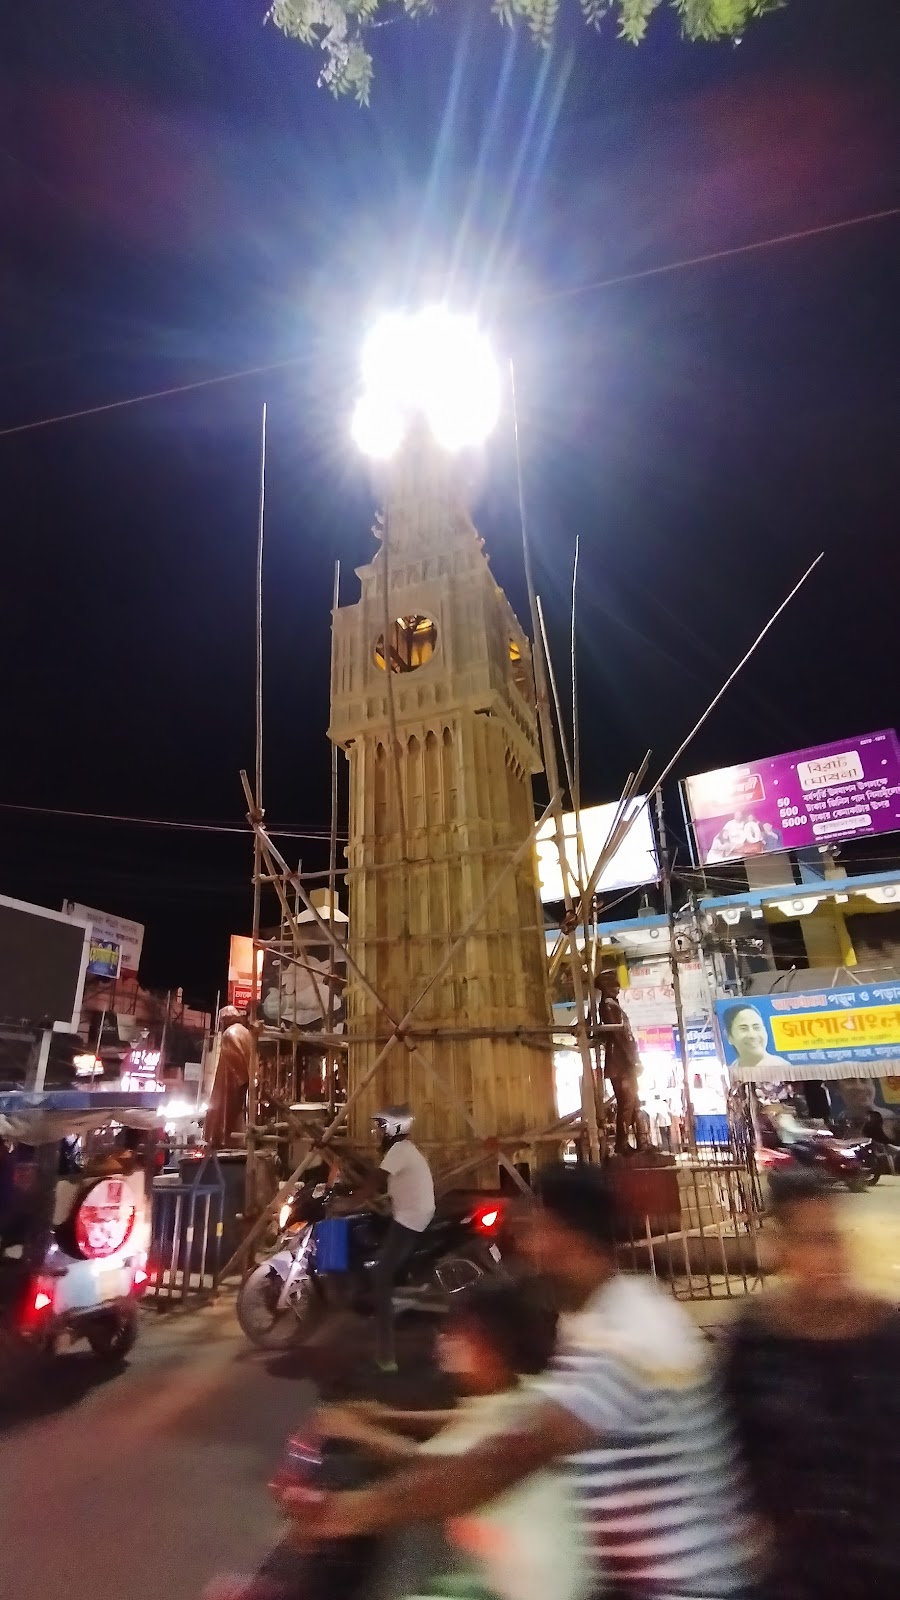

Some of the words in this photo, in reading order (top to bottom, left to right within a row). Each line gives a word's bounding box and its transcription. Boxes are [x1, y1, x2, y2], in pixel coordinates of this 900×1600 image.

[777, 797, 790, 807] 50
[780, 805, 799, 818] 500
[782, 815, 807, 828] 5000
[859, 991, 870, 1002] ও
[780, 1012, 900, 1038] জাগোবাংল
